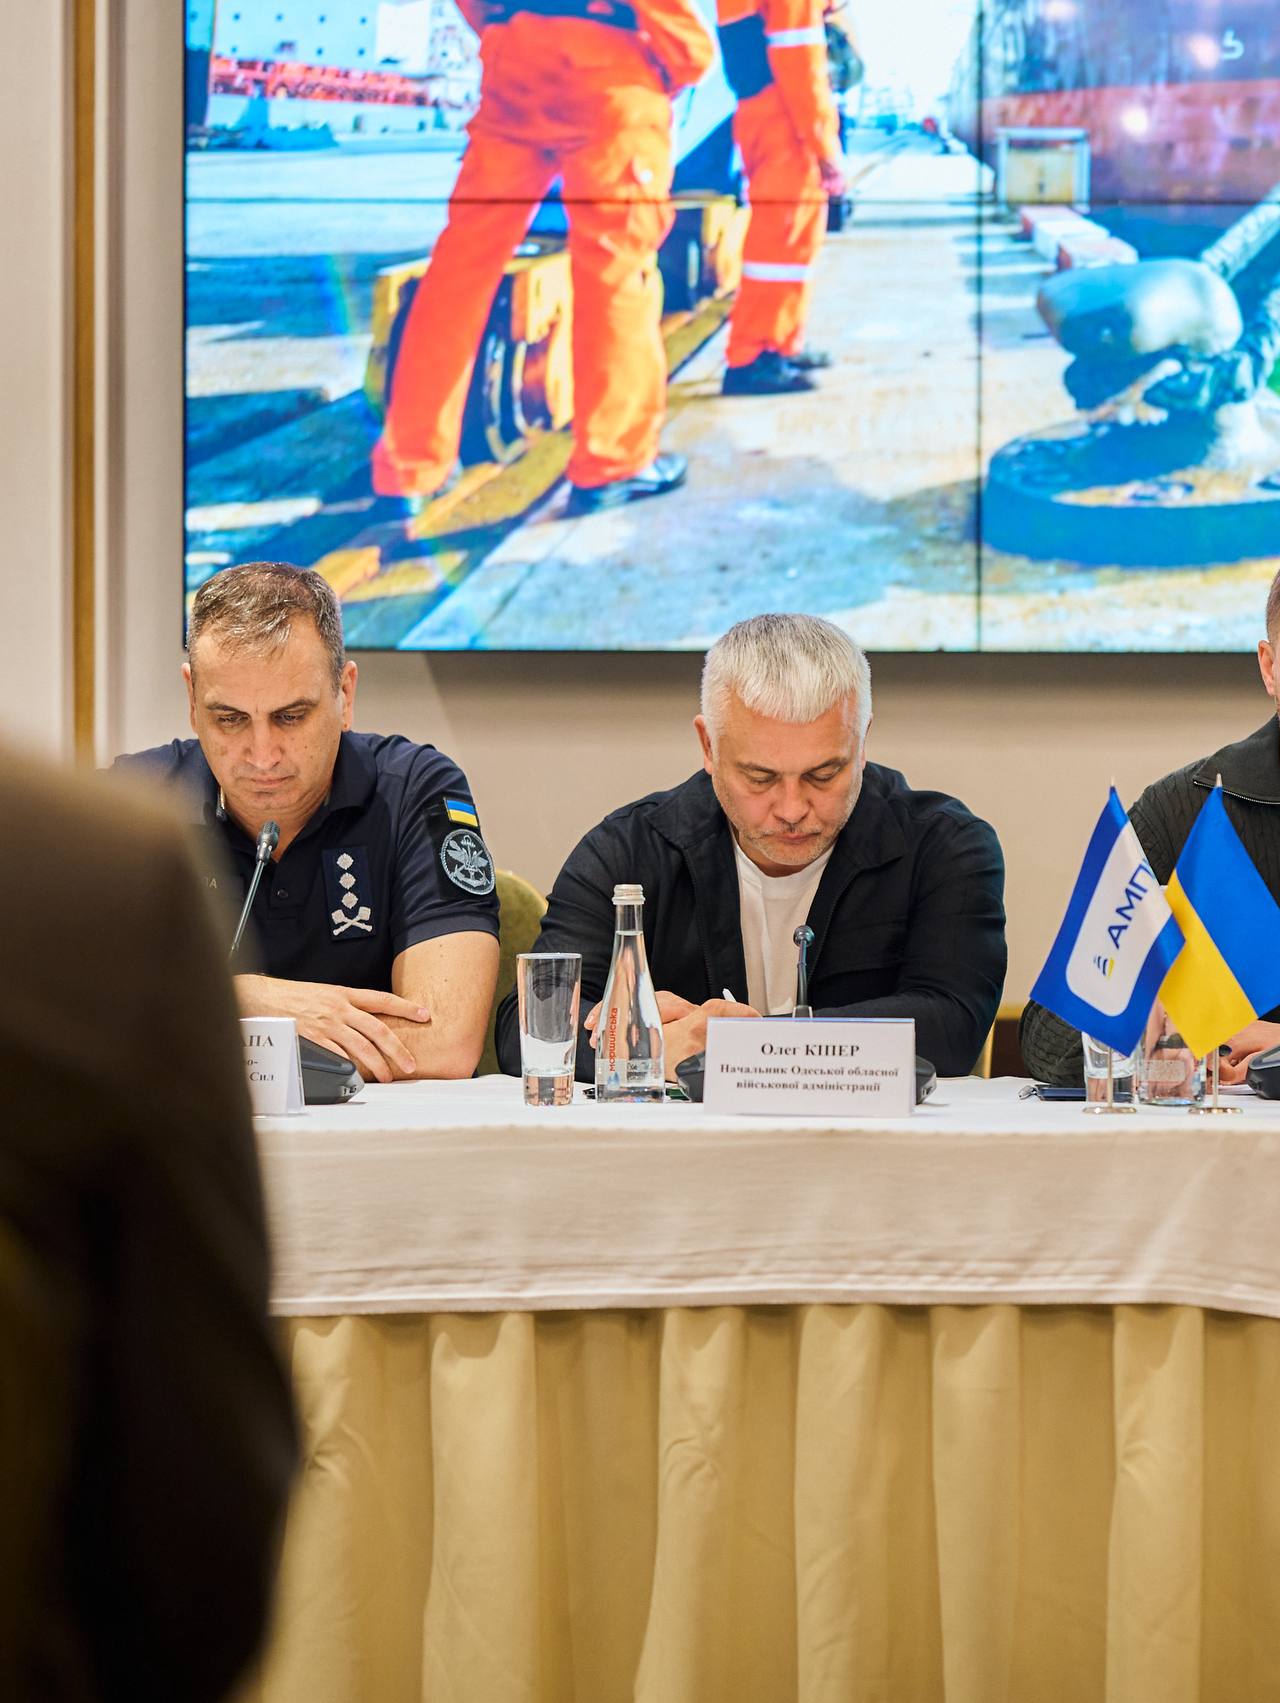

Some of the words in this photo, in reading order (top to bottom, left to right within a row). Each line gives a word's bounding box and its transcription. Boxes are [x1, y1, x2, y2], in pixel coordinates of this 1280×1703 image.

[1108, 858, 1157, 950] АМП
[609, 1007, 618, 1072] моршинська
[760, 1042, 800, 1057] Олег
[804, 1043, 860, 1057] КІПЕР
[720, 1064, 787, 1075] Начальник
[791, 1066, 844, 1077] Одеської
[847, 1066, 899, 1078] обласної
[736, 1079, 799, 1090] військової
[802, 1081, 881, 1093] адміністрації
